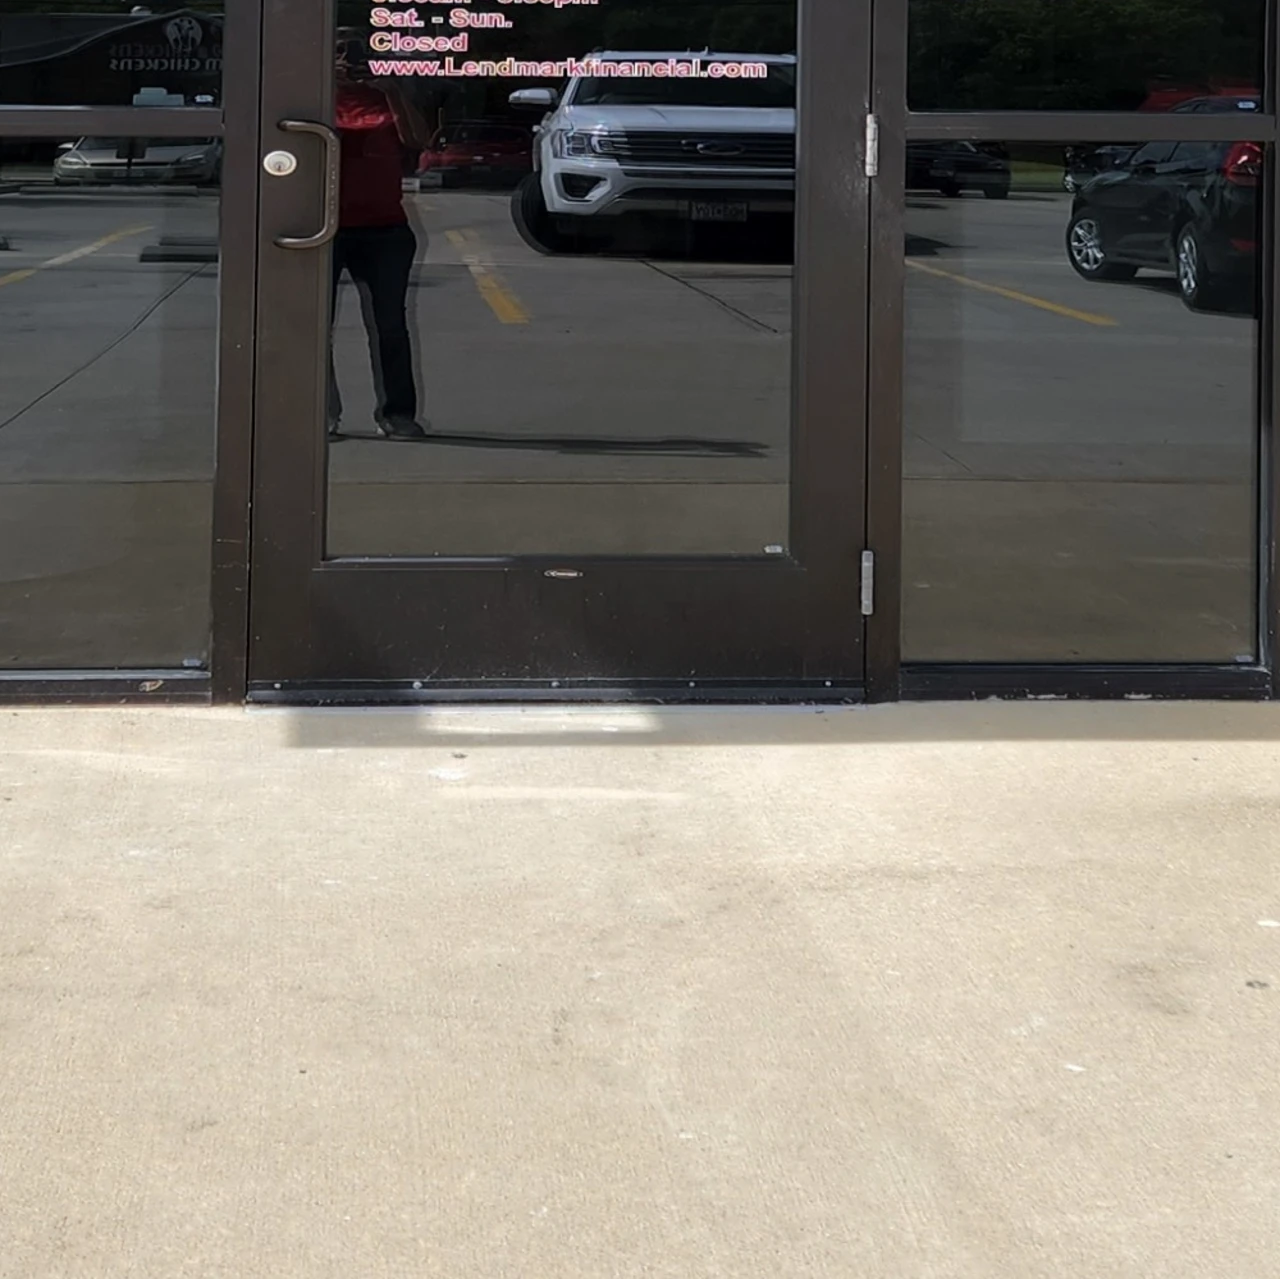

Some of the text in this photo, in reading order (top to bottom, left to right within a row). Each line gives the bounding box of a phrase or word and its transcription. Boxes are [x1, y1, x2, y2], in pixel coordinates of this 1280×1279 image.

[369, 7, 513, 28] Sat. - Sun.
[369, 31, 469, 52] Closed
[368, 57, 768, 78] www.Lendmarkfinancial.com
